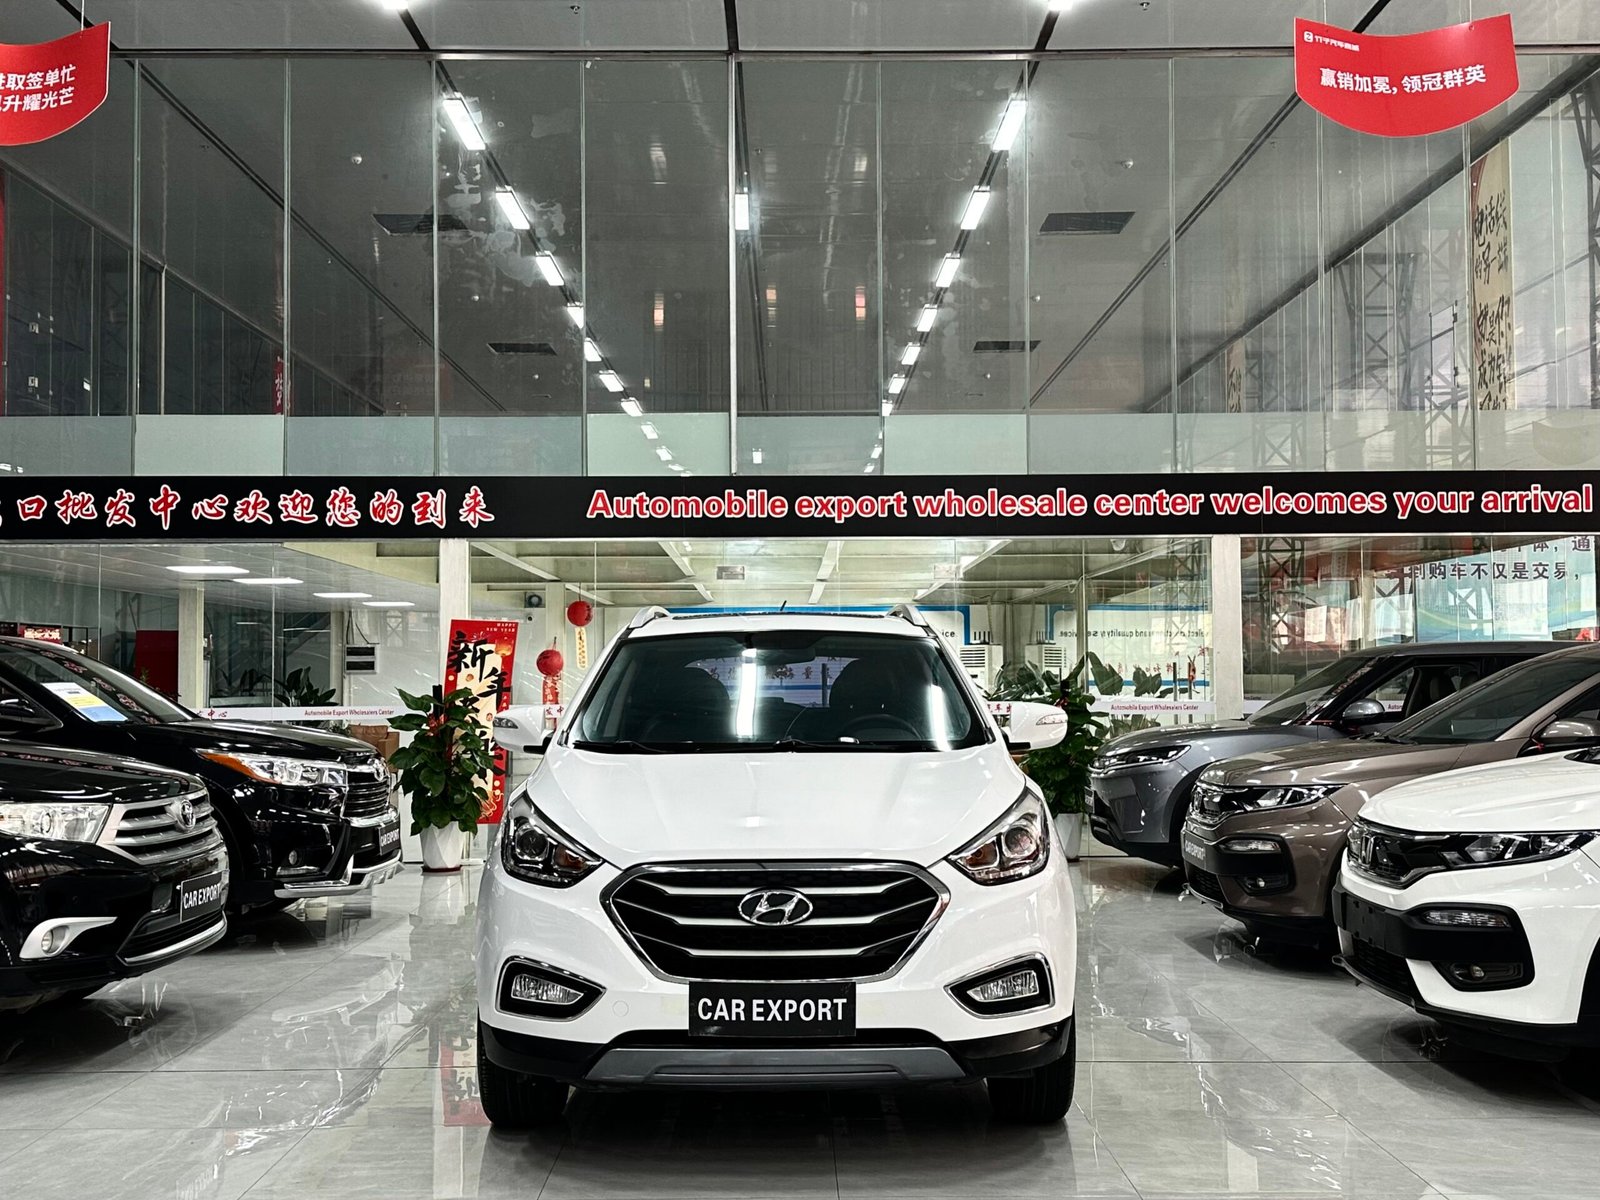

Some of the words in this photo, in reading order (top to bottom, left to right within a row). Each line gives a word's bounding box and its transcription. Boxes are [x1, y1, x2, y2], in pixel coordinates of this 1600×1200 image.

[0, 86, 75, 113] 升耀光芒
[0, 484, 496, 531] 口批发中心欢迎您的到来
[586, 489, 788, 519] Automobile
[795, 491, 907, 523] export
[912, 488, 1087, 518] wholesale
[1094, 489, 1204, 516] center
[1210, 486, 1387, 516] welcomes
[1393, 491, 1474, 519] your
[1481, 484, 1593, 513] arrival
[333, 709, 348, 717] Export
[379, 708, 394, 716] Center
[1138, 704, 1153, 712] Export
[1183, 703, 1199, 711] Center
[184, 890, 197, 909] CAR
[198, 883, 221, 905] EXPORT
[698, 998, 746, 1021] CAR
[752, 999, 847, 1022] EXPORT
